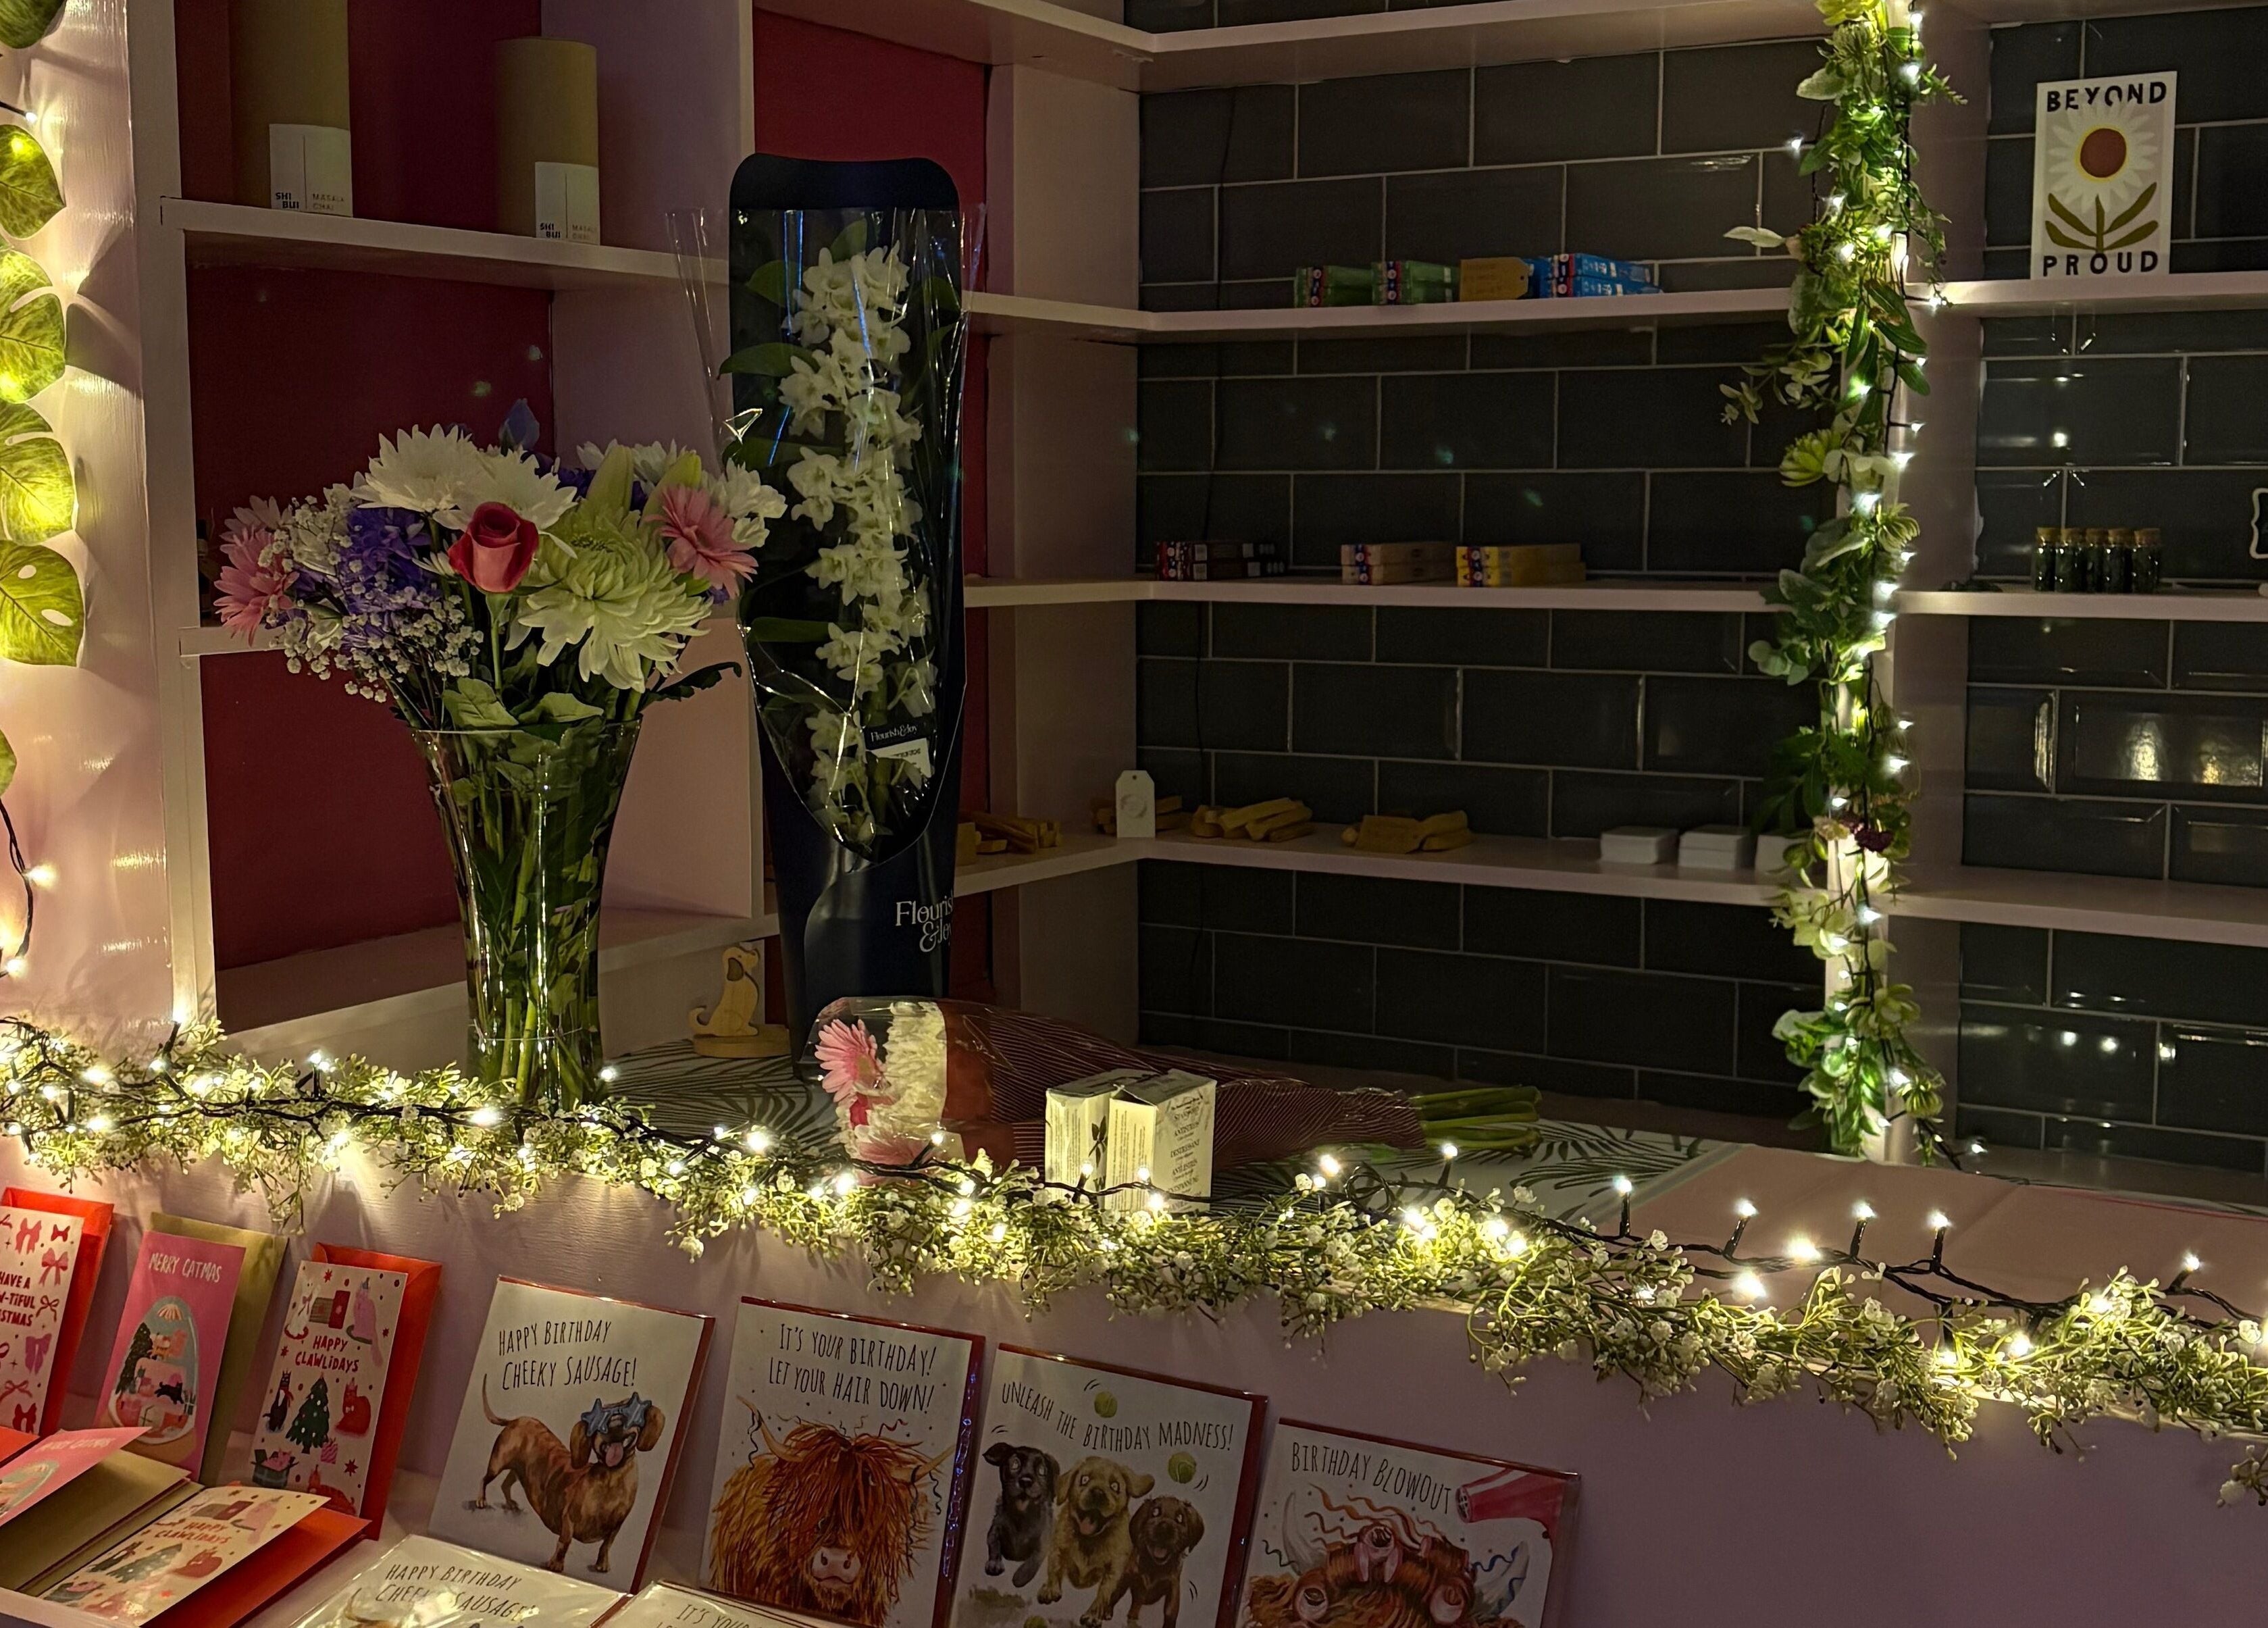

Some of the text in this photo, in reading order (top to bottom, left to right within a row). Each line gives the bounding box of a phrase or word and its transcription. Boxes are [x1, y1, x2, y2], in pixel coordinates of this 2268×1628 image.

[2047, 82, 2167, 112] BEYOND
[2043, 251, 2158, 277] PROUD
[0, 1271, 31, 1289] HAVE A
[149, 1252, 222, 1283] MERRY CATMAS
[0, 1309, 33, 1327] STMAS
[313, 1336, 349, 1352] HAPPY
[499, 1320, 611, 1356] HAPPY BIRTHDAY
[780, 1323, 937, 1377] IT'S YOUR BIRTHDAY!
[502, 1355, 637, 1390] CHEEKY SAUSAGE!
[769, 1356, 935, 1414] LET YOUR HAIR DOWN!
[1002, 1381, 1233, 1452] UNLEASH THE BIRTHDAY MADNESS!
[1292, 1442, 1451, 1514] BIRTHDAY BLOWOUT
[385, 1564, 522, 1591] HAPPY BIRTHDAY
[676, 1604, 750, 1628] IT'S YO
